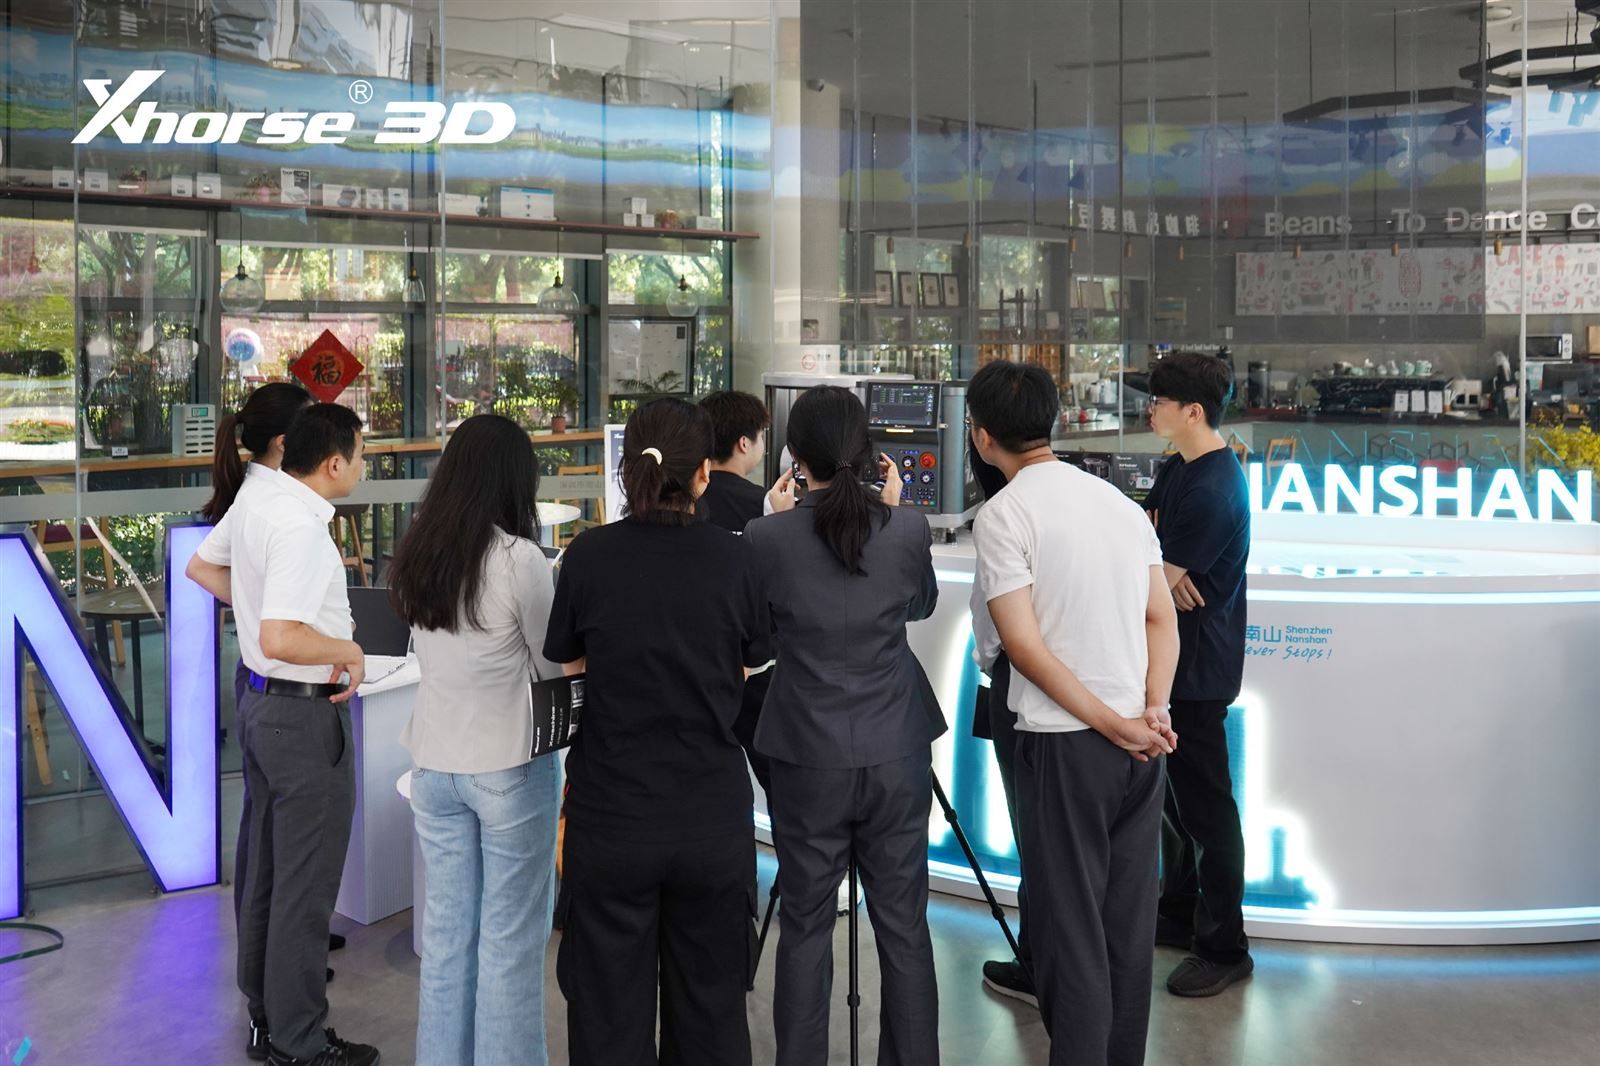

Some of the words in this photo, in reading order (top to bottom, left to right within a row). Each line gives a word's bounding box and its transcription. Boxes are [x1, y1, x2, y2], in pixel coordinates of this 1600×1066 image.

[71, 70, 355, 144] Xhorse
[374, 101, 517, 144] 3D
[1264, 211, 1353, 236] Beans
[1391, 208, 1426, 233] To
[1447, 206, 1547, 232] Dance
[1571, 203, 1600, 229] C
[311, 355, 341, 384] 福
[1245, 624, 1281, 643] 南山
[1285, 625, 1333, 635] Shenzhen
[1285, 635, 1328, 644] Nanshan
[1245, 645, 1277, 655] ever
